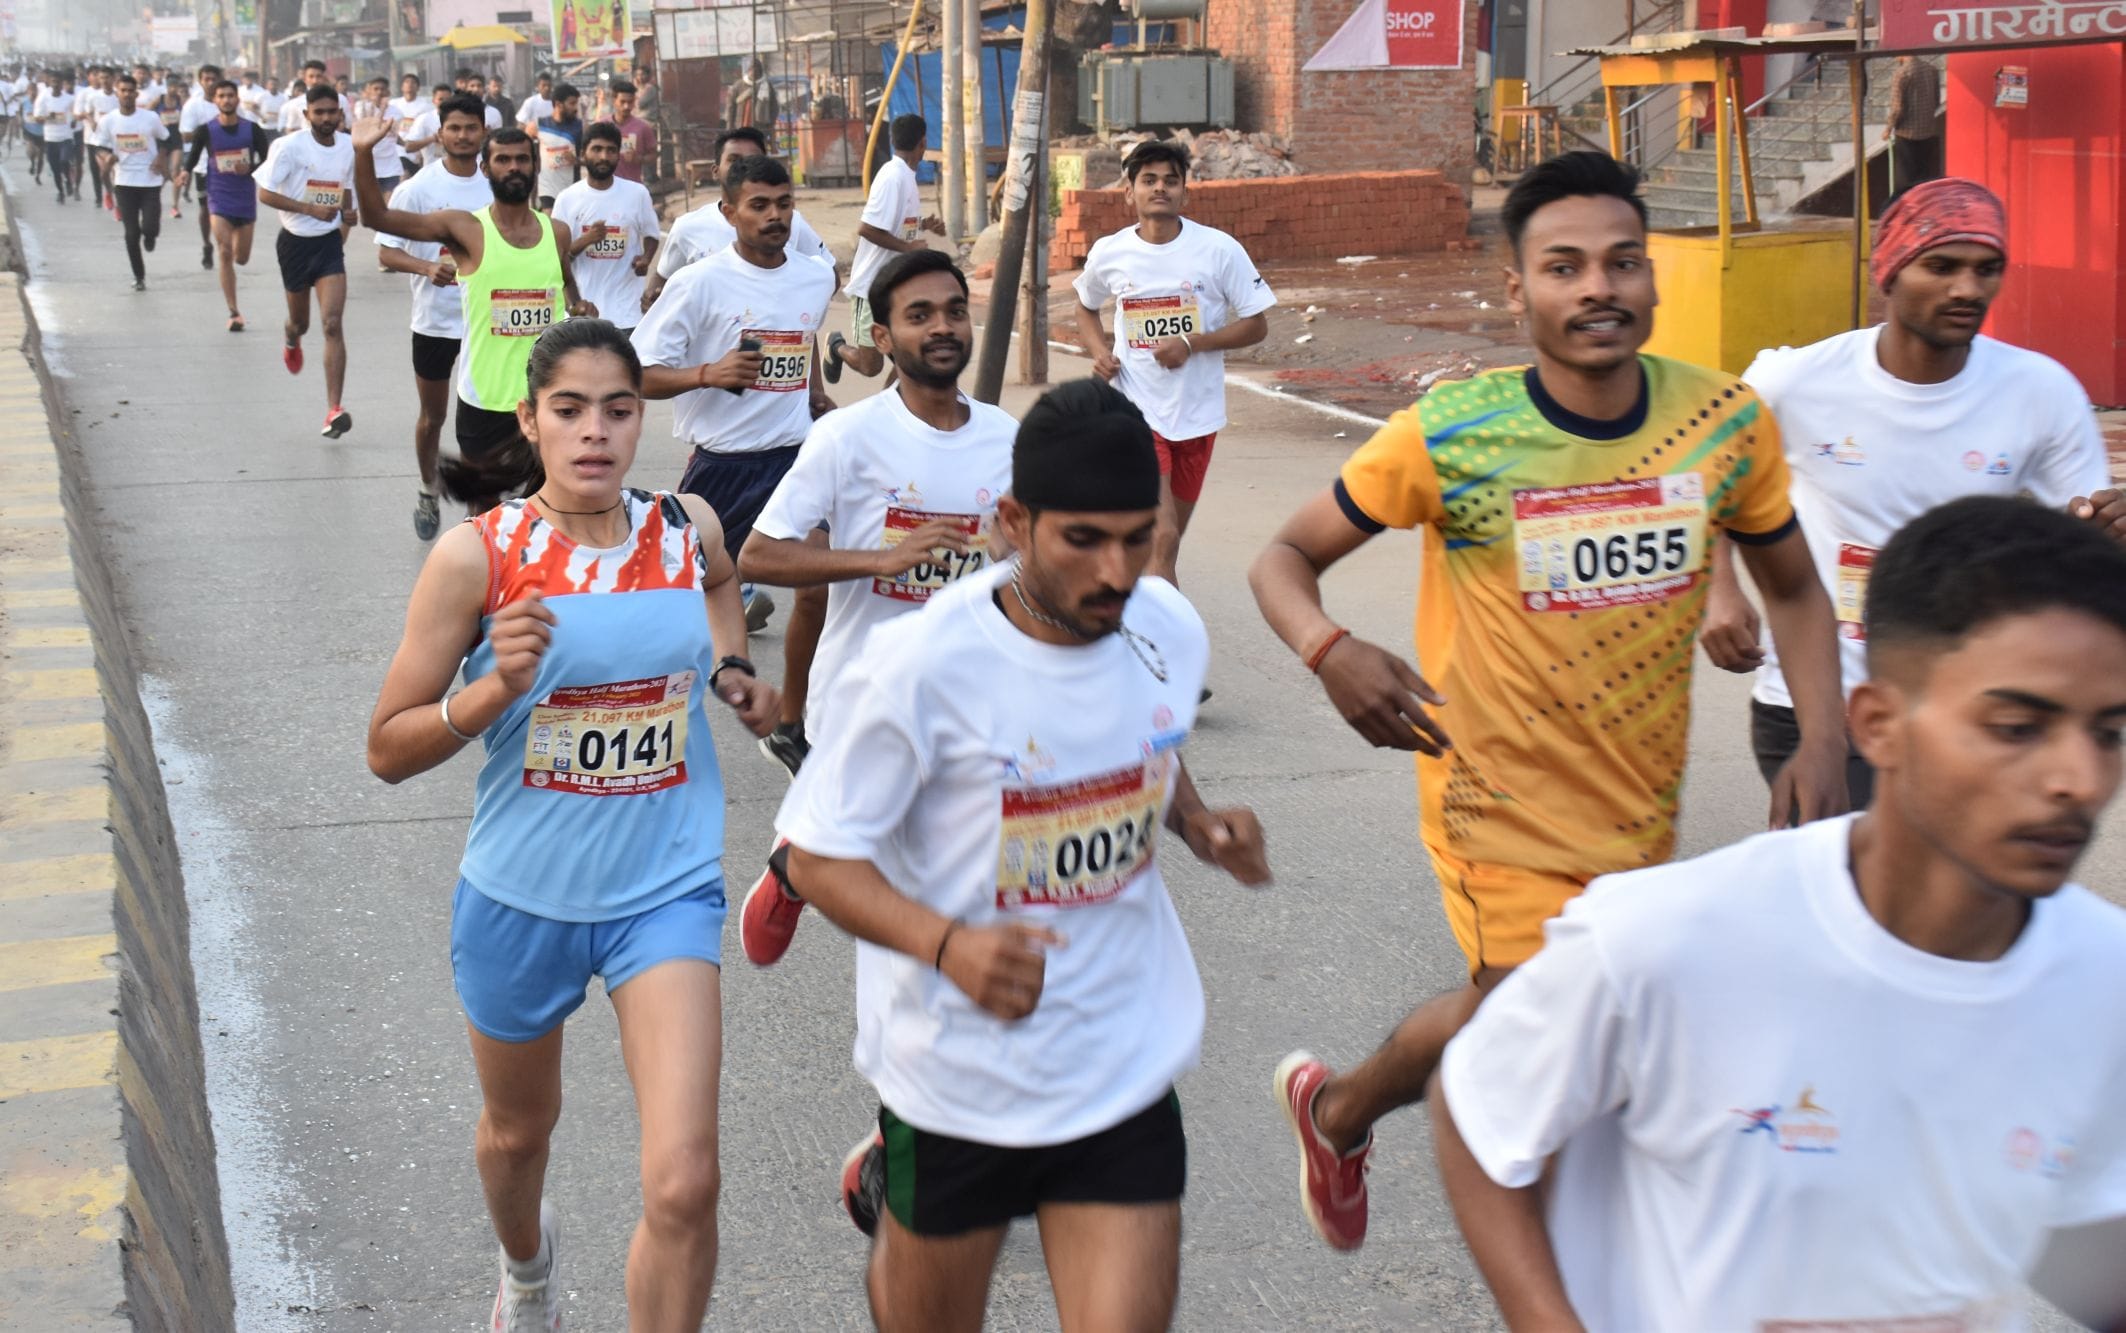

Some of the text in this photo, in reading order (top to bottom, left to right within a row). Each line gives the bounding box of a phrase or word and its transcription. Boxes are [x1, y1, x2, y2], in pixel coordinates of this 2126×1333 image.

[1386, 11, 1435, 30] SHOP
[595, 239, 625, 251] 0534
[511, 307, 551, 326] 0319
[1144, 315, 1193, 337] 0256
[760, 355, 806, 378] 0596
[915, 550, 982, 583] 0472
[1574, 528, 1688, 583] 0655
[582, 711, 623, 724] 21.097
[626, 711, 645, 722] KM
[646, 700, 686, 719] Marathon
[578, 720, 673, 771] 0141
[554, 773, 569, 783] Dr.
[603, 774, 637, 787] Avadh
[637, 766, 677, 785] University
